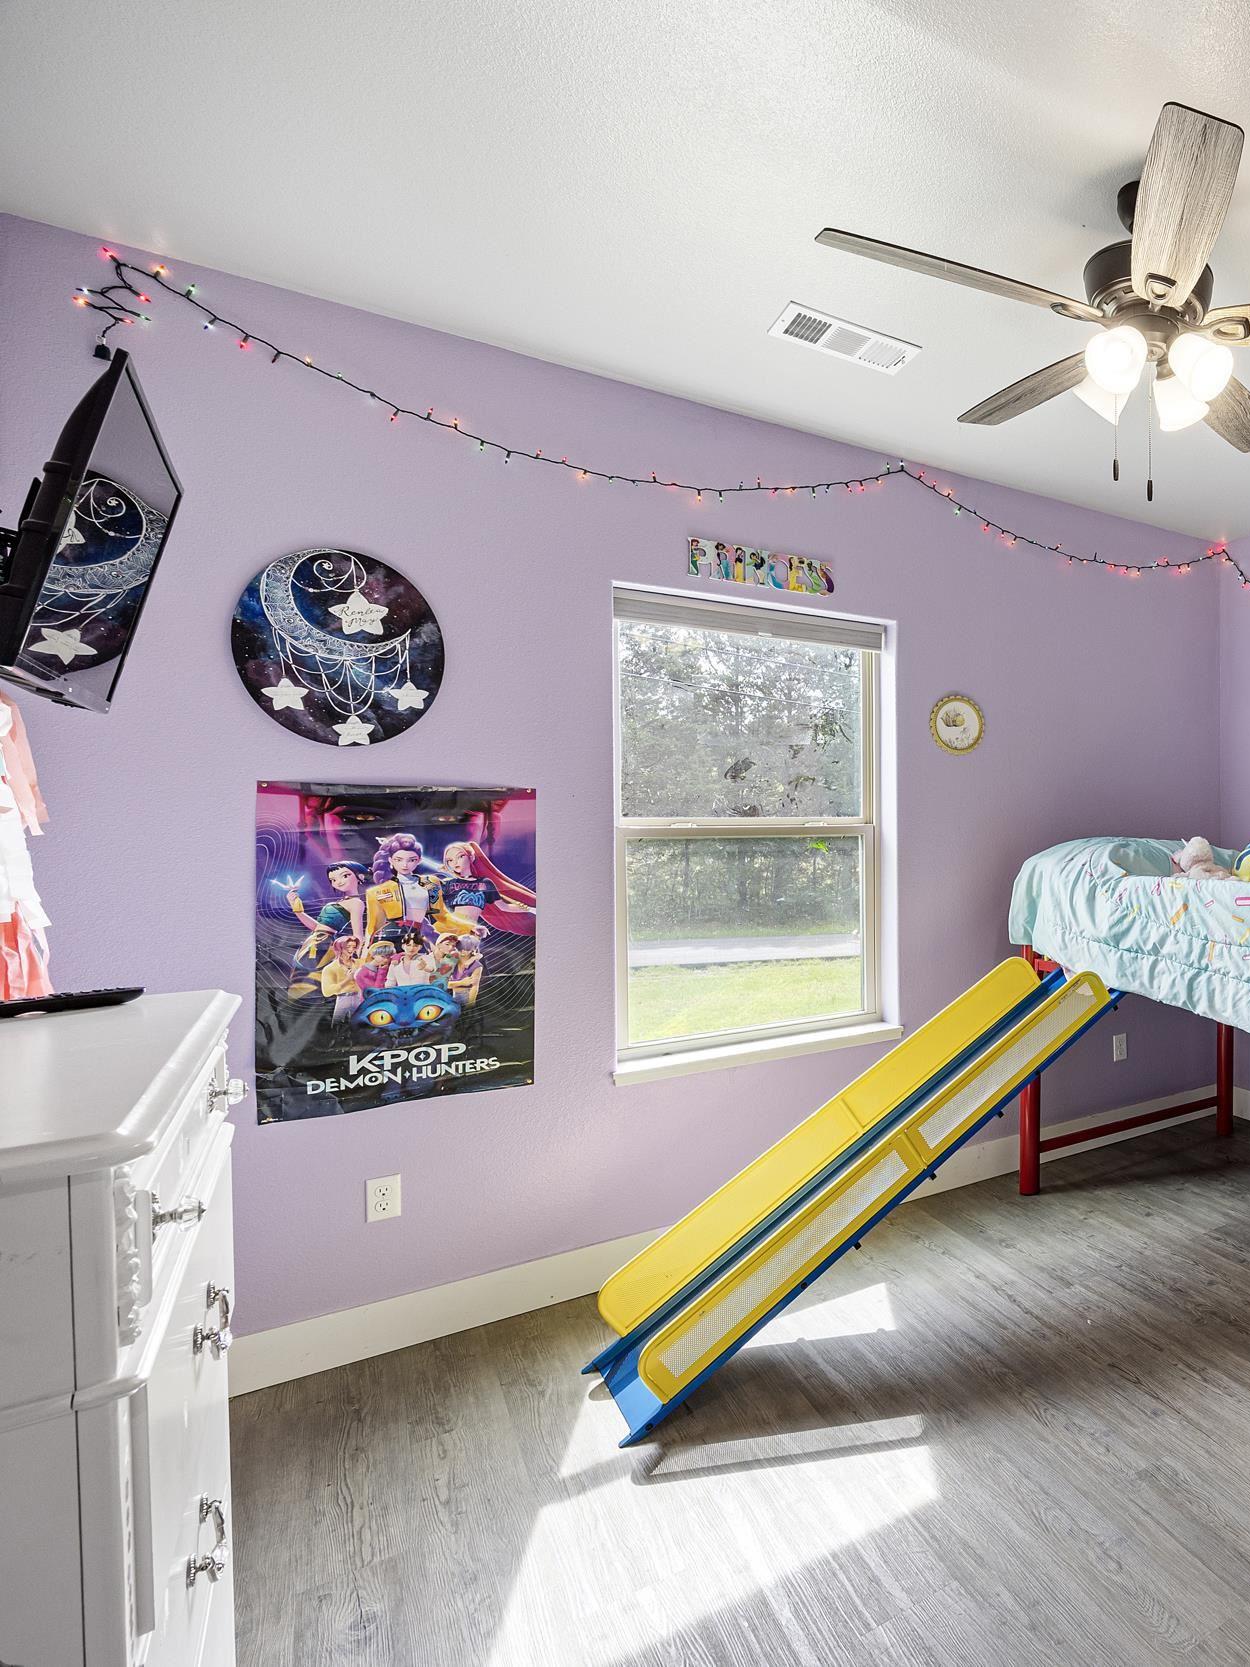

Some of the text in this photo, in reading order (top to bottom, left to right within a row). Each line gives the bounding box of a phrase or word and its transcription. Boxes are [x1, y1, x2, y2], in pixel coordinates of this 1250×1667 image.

[688, 537, 835, 597] PRINCESS
[306, 1057, 500, 1095] DEMON HUNTERS
